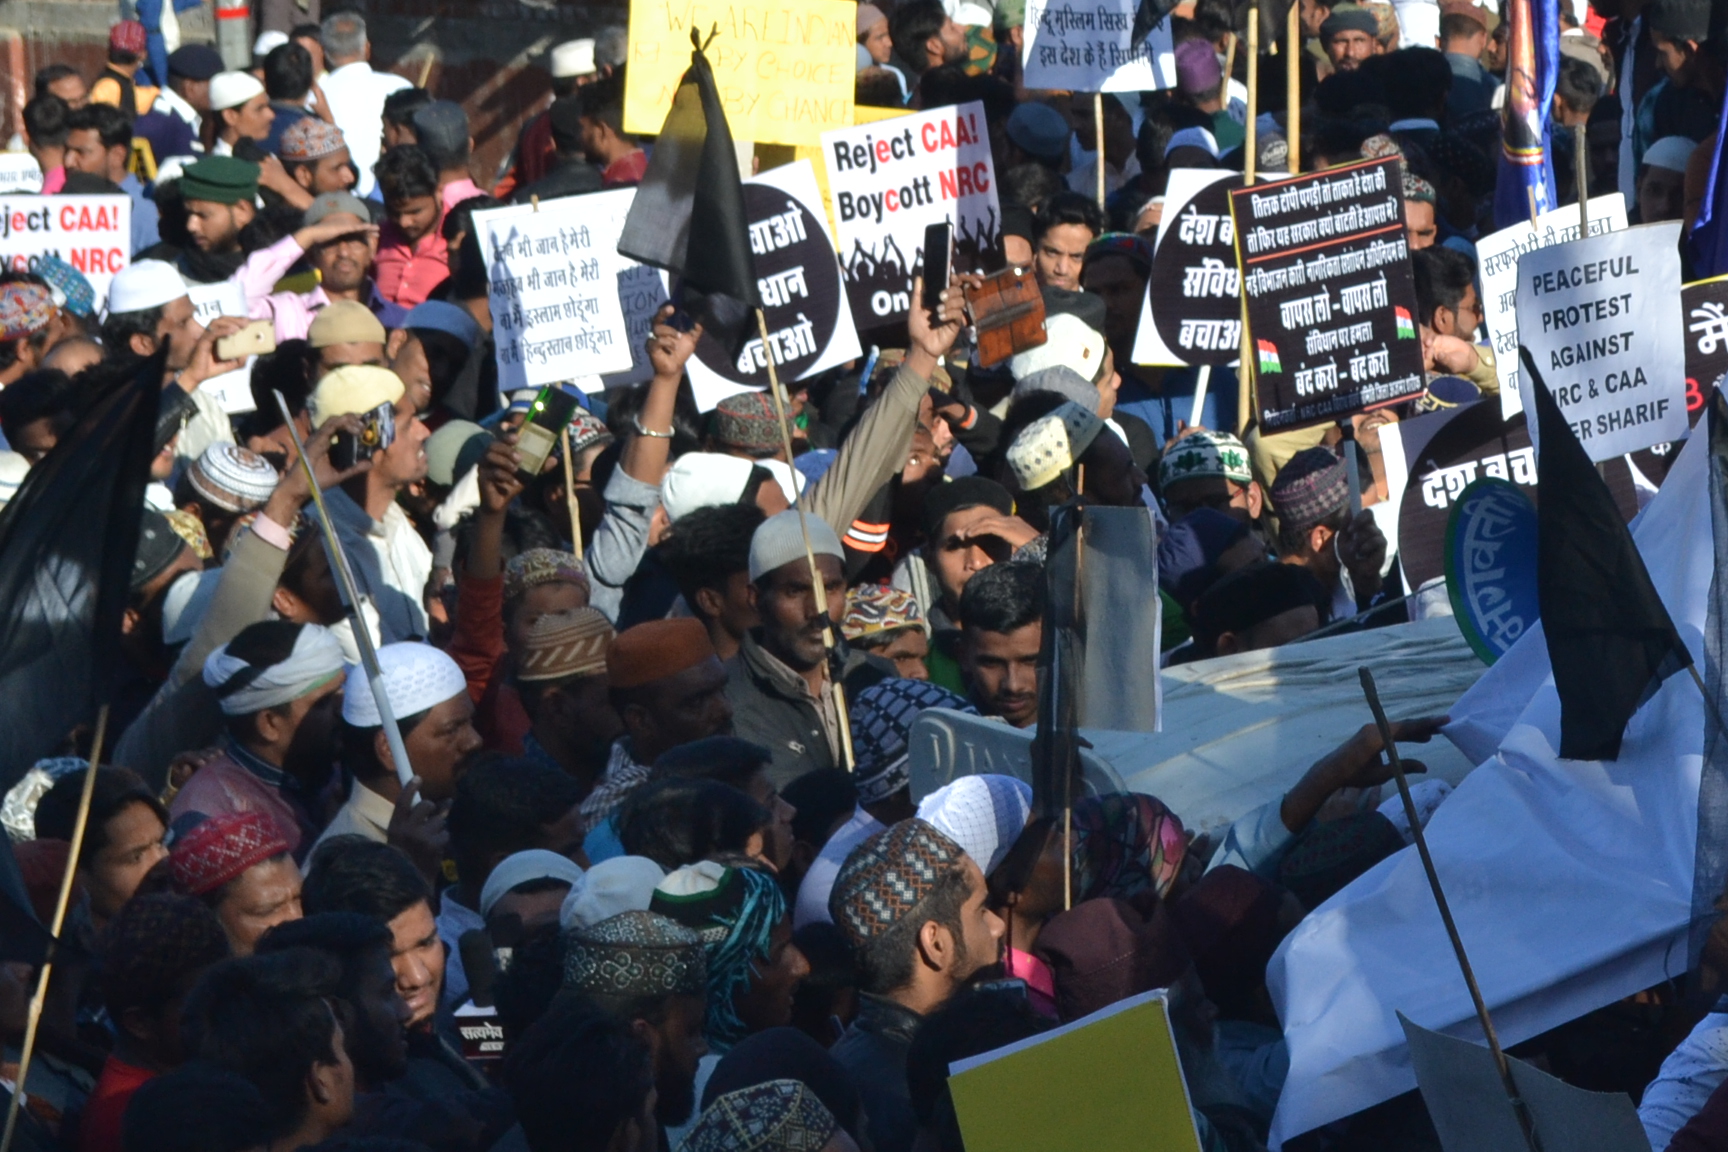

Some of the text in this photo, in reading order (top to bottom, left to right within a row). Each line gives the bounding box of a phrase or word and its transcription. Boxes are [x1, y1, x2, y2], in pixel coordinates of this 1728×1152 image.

[1097, 3, 1129, 32] सिख
[756, 49, 845, 85] CHOICE
[1039, 43, 1058, 68] इस
[1060, 39, 1081, 67] देश
[1084, 41, 1096, 67] के
[833, 112, 980, 175] Reject CAA!
[837, 160, 990, 225] Boycott NRC
[59, 205, 119, 232] CAA!
[1178, 204, 1220, 246] देश
[1290, 218, 1319, 244] सरकार
[70, 247, 124, 275] NRC
[1532, 254, 1640, 297] PEACEFUL
[525, 299, 563, 331] इस्लाम
[871, 289, 910, 317] On
[1279, 270, 1388, 331] वापस लो वापस लो
[1541, 293, 1633, 334] PROTEST
[1305, 328, 1339, 356] संविधान
[1338, 326, 1351, 348] पर
[1550, 330, 1635, 371] AGAINST
[1294, 341, 1391, 397] बंद करो बंद करो
[1588, 366, 1648, 400] & CAA
[1596, 397, 1671, 437] SHARIF
